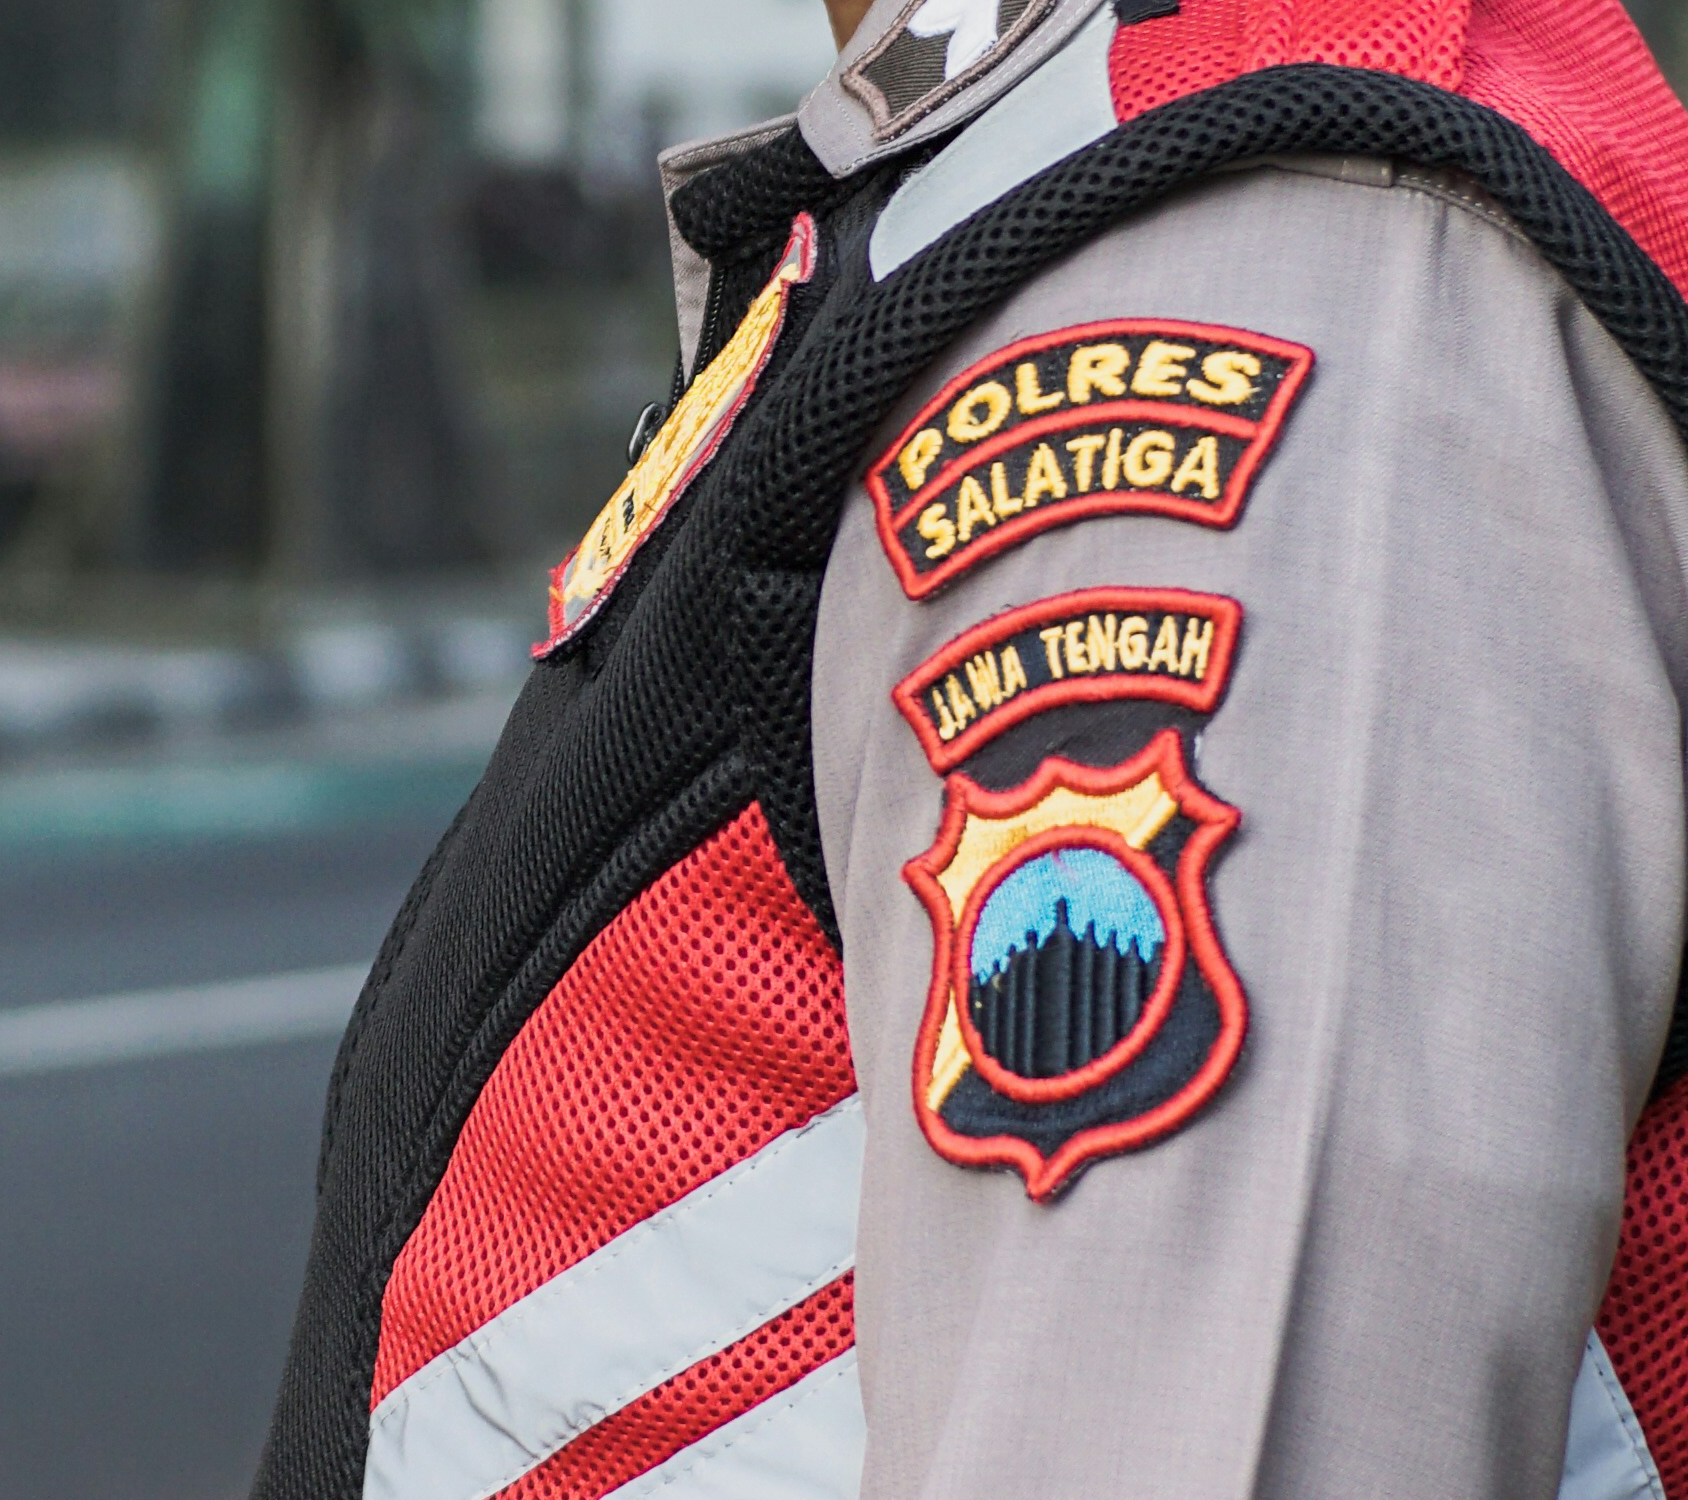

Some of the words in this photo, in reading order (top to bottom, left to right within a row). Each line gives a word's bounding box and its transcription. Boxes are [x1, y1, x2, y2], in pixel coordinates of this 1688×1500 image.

[899, 340, 1261, 490] POLRES
[916, 428, 1219, 559] SALATIGA
[933, 646, 1027, 740] JAWA
[1040, 614, 1214, 678] TENGAH
